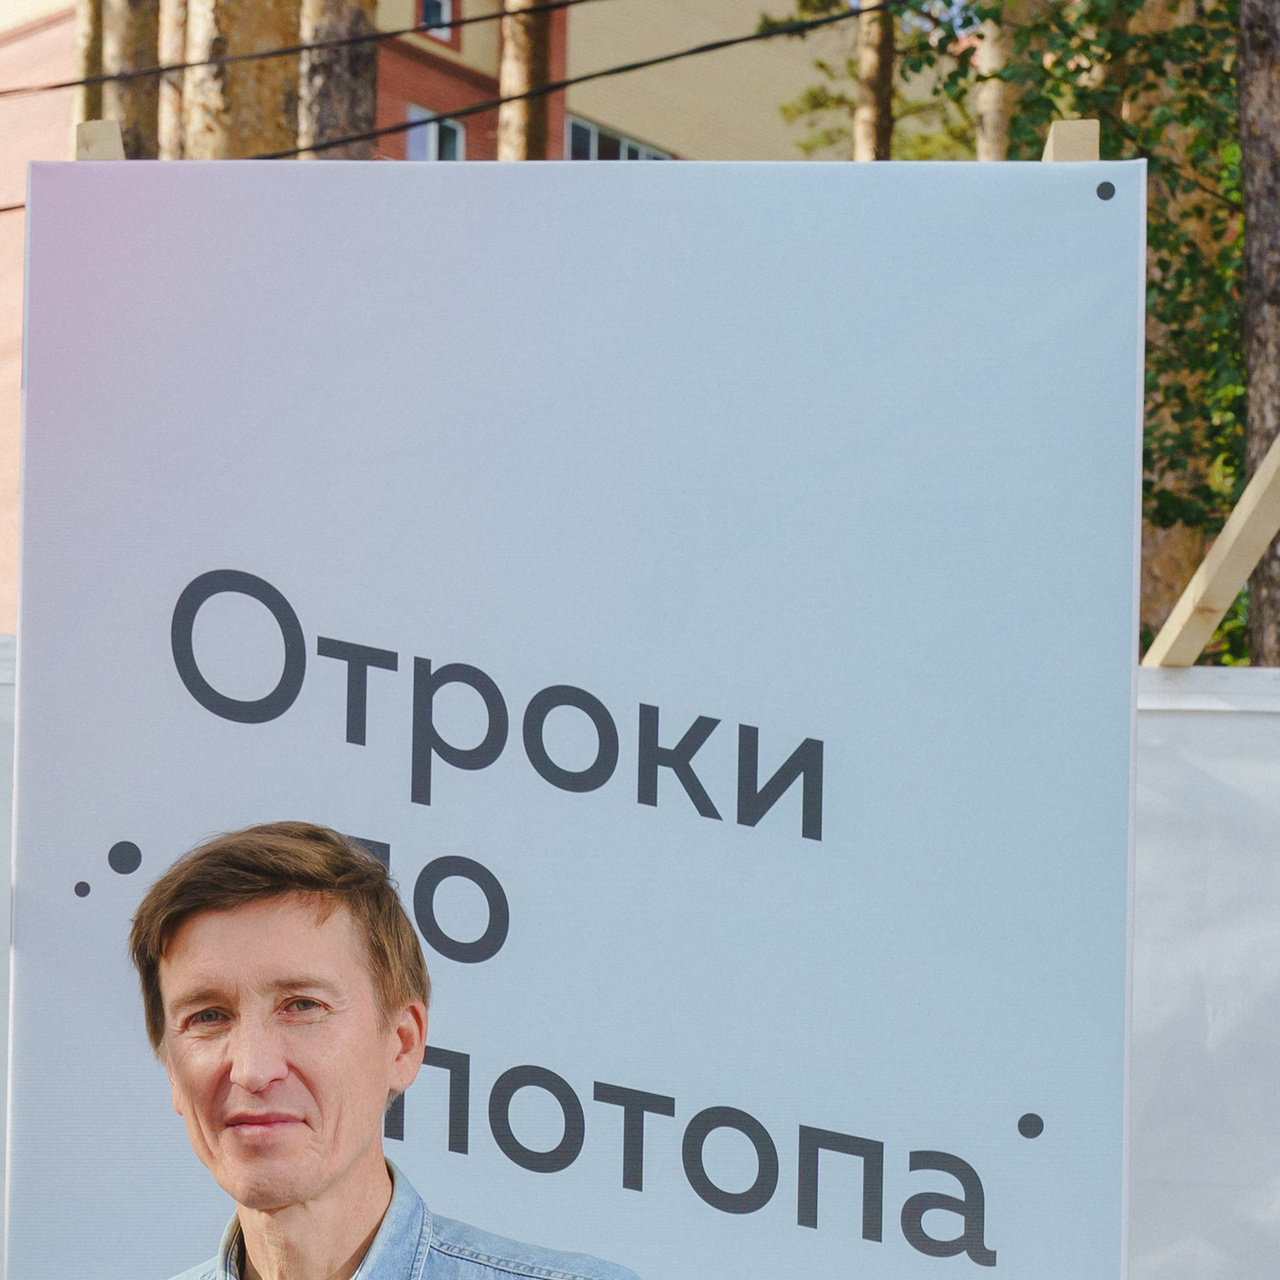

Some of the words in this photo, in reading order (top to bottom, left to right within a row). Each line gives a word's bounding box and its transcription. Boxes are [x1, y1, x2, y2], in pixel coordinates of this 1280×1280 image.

[171, 569, 824, 841] Отроки
[346, 834, 510, 963] о
[384, 1045, 997, 1267] потопа
